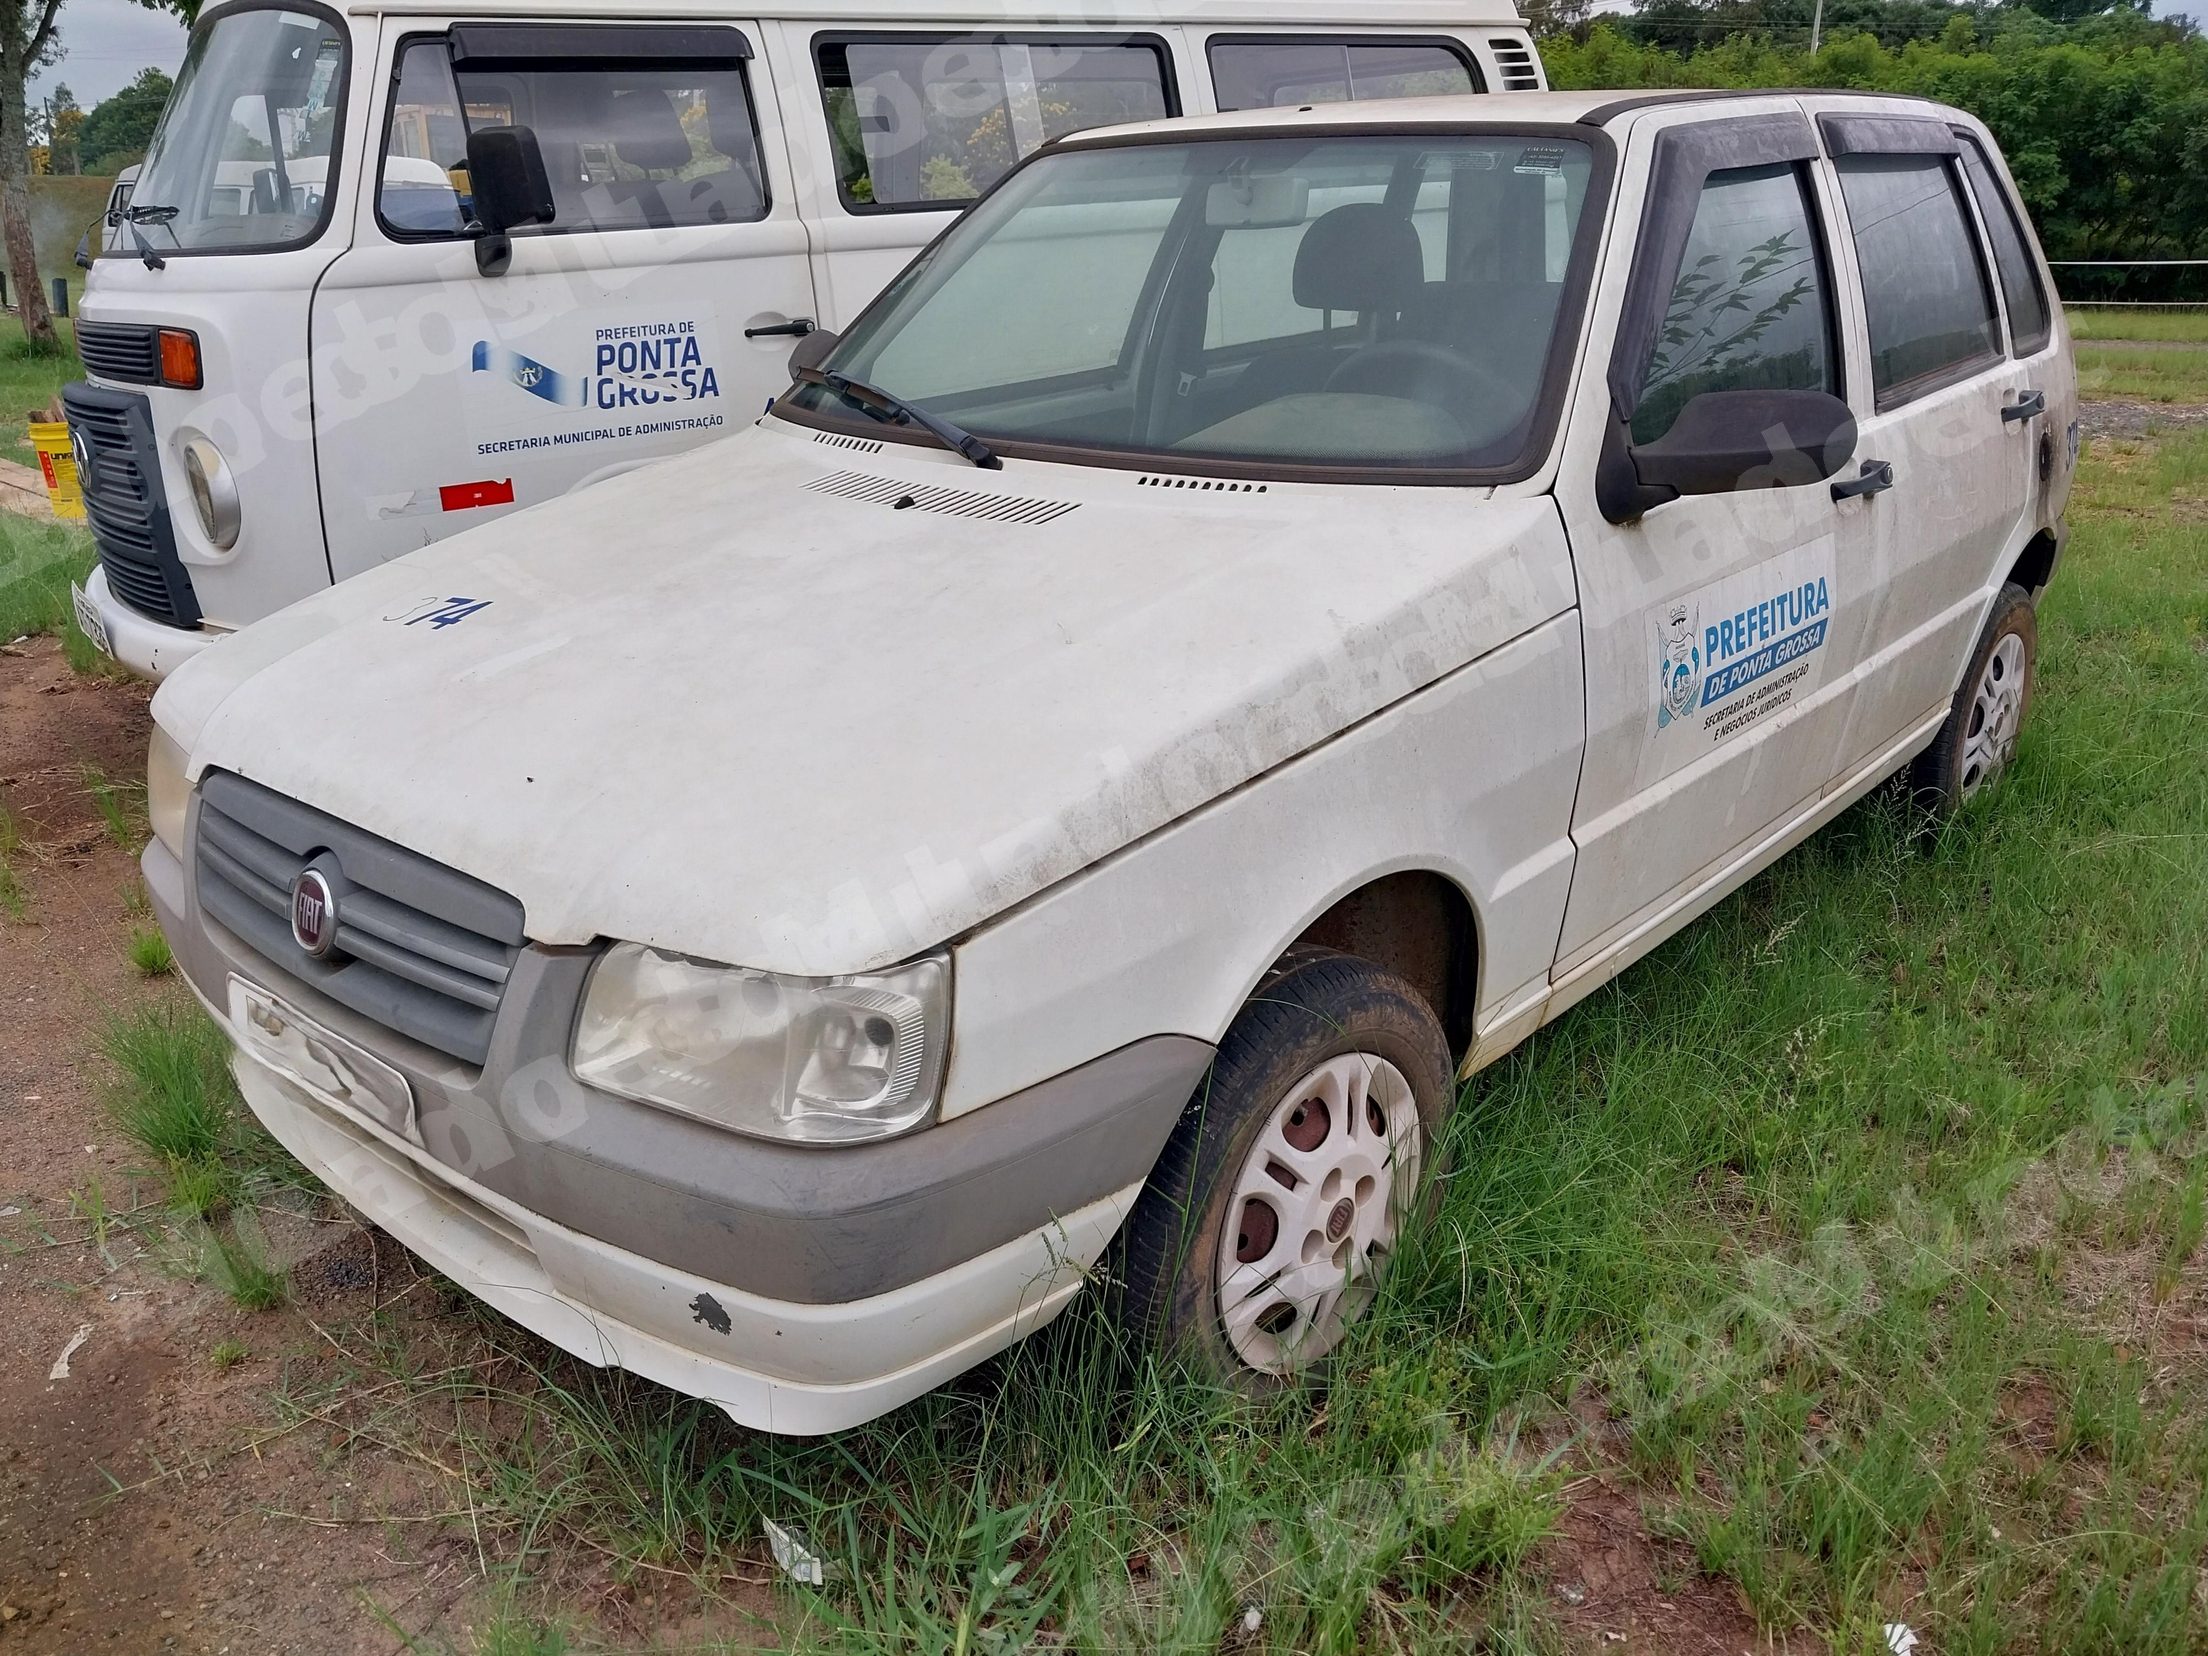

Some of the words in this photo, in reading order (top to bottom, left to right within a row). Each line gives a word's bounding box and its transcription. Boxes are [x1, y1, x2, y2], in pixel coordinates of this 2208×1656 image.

[595, 323, 676, 341] PREFEITURA
[679, 321, 695, 334] DE
[596, 336, 702, 376] PONTA
[477, 435, 551, 455] SECRETARIA
[553, 428, 616, 446] MUNICIPAL
[618, 426, 633, 437] DE
[635, 414, 723, 435] ADMINISTRAÇÃO
[1705, 576, 1829, 668] PREFEITURA
[1709, 671, 1729, 699] DE
[1729, 650, 1772, 688] PONTA
[1775, 625, 1821, 664] GROSSA
[1703, 698, 1745, 731] SECRETARIA
[1745, 691, 1756, 708] DE
[1755, 662, 1809, 702] ADMINISTRAÇÃO
[1713, 728, 1720, 742] E
[1720, 707, 1758, 738] NEGÓCIOS
[298, 891, 323, 935] FIAT
